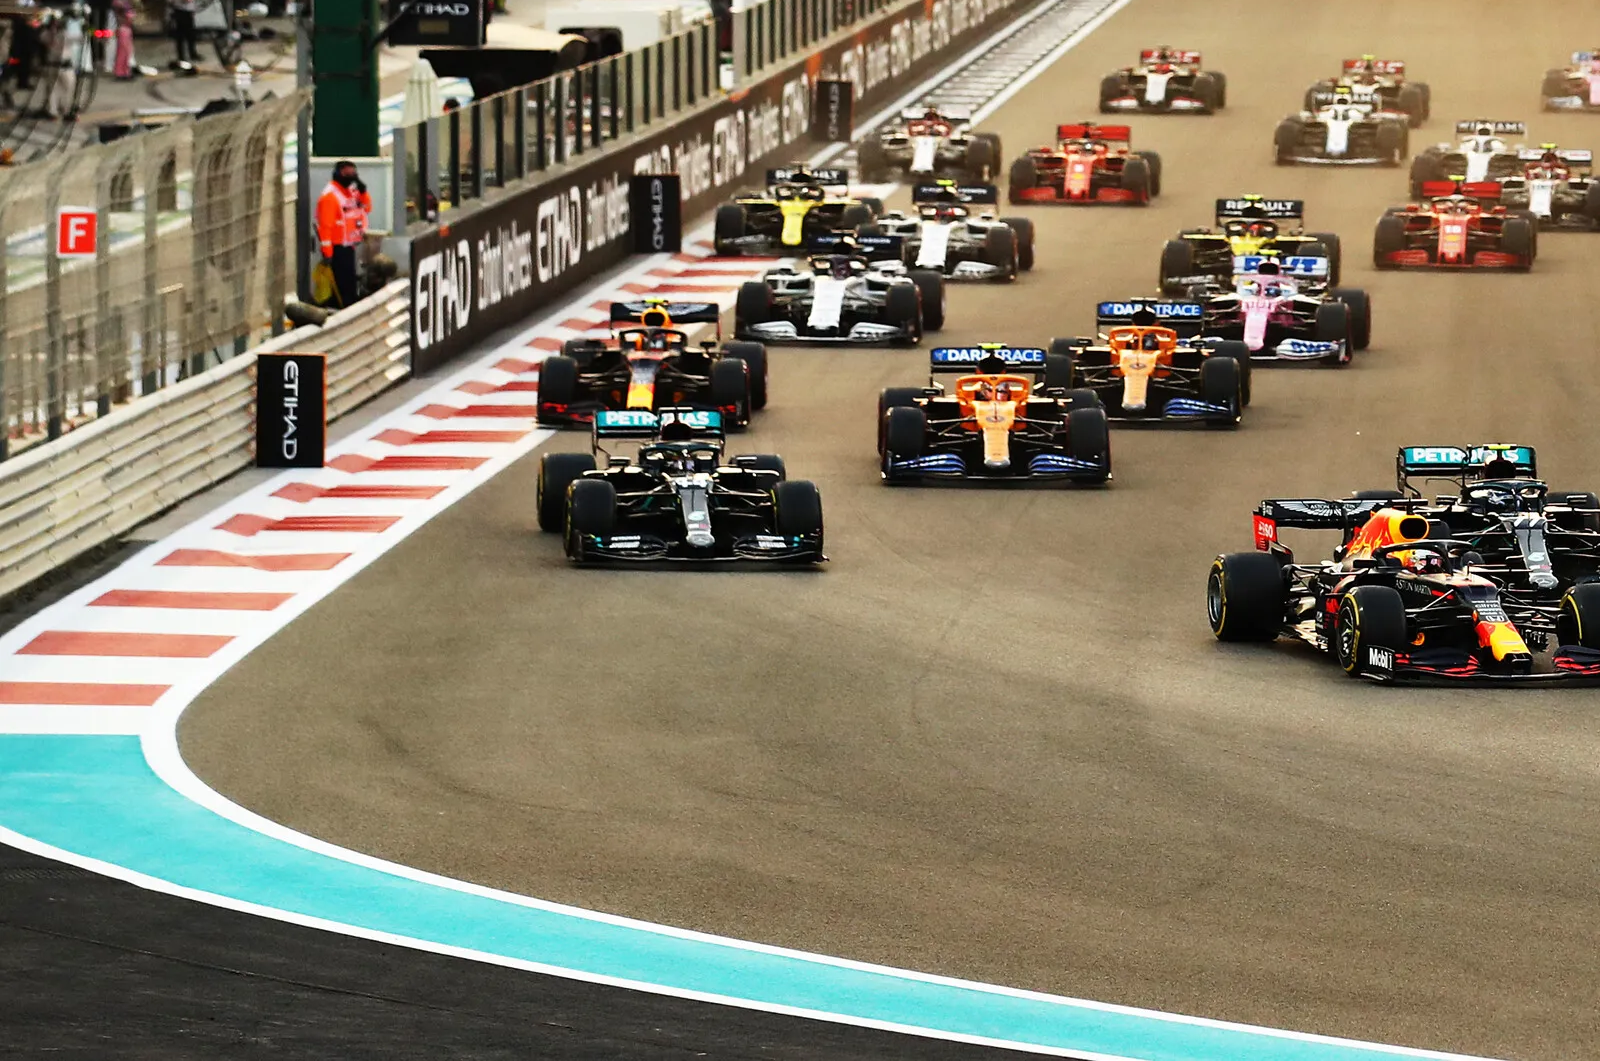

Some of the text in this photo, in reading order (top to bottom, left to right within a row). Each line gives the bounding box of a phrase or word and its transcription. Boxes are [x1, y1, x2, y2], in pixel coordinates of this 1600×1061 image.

[1226, 200, 1294, 210] REAULT
[69, 217, 88, 250] F
[536, 186, 582, 283] ETIHAD
[416, 239, 472, 350] ETIHAD
[1113, 304, 1200, 316] DARTRACE
[282, 360, 299, 460] ETIHAD
[605, 411, 709, 425] PETRAS
[1413, 447, 1520, 463] PETRS
